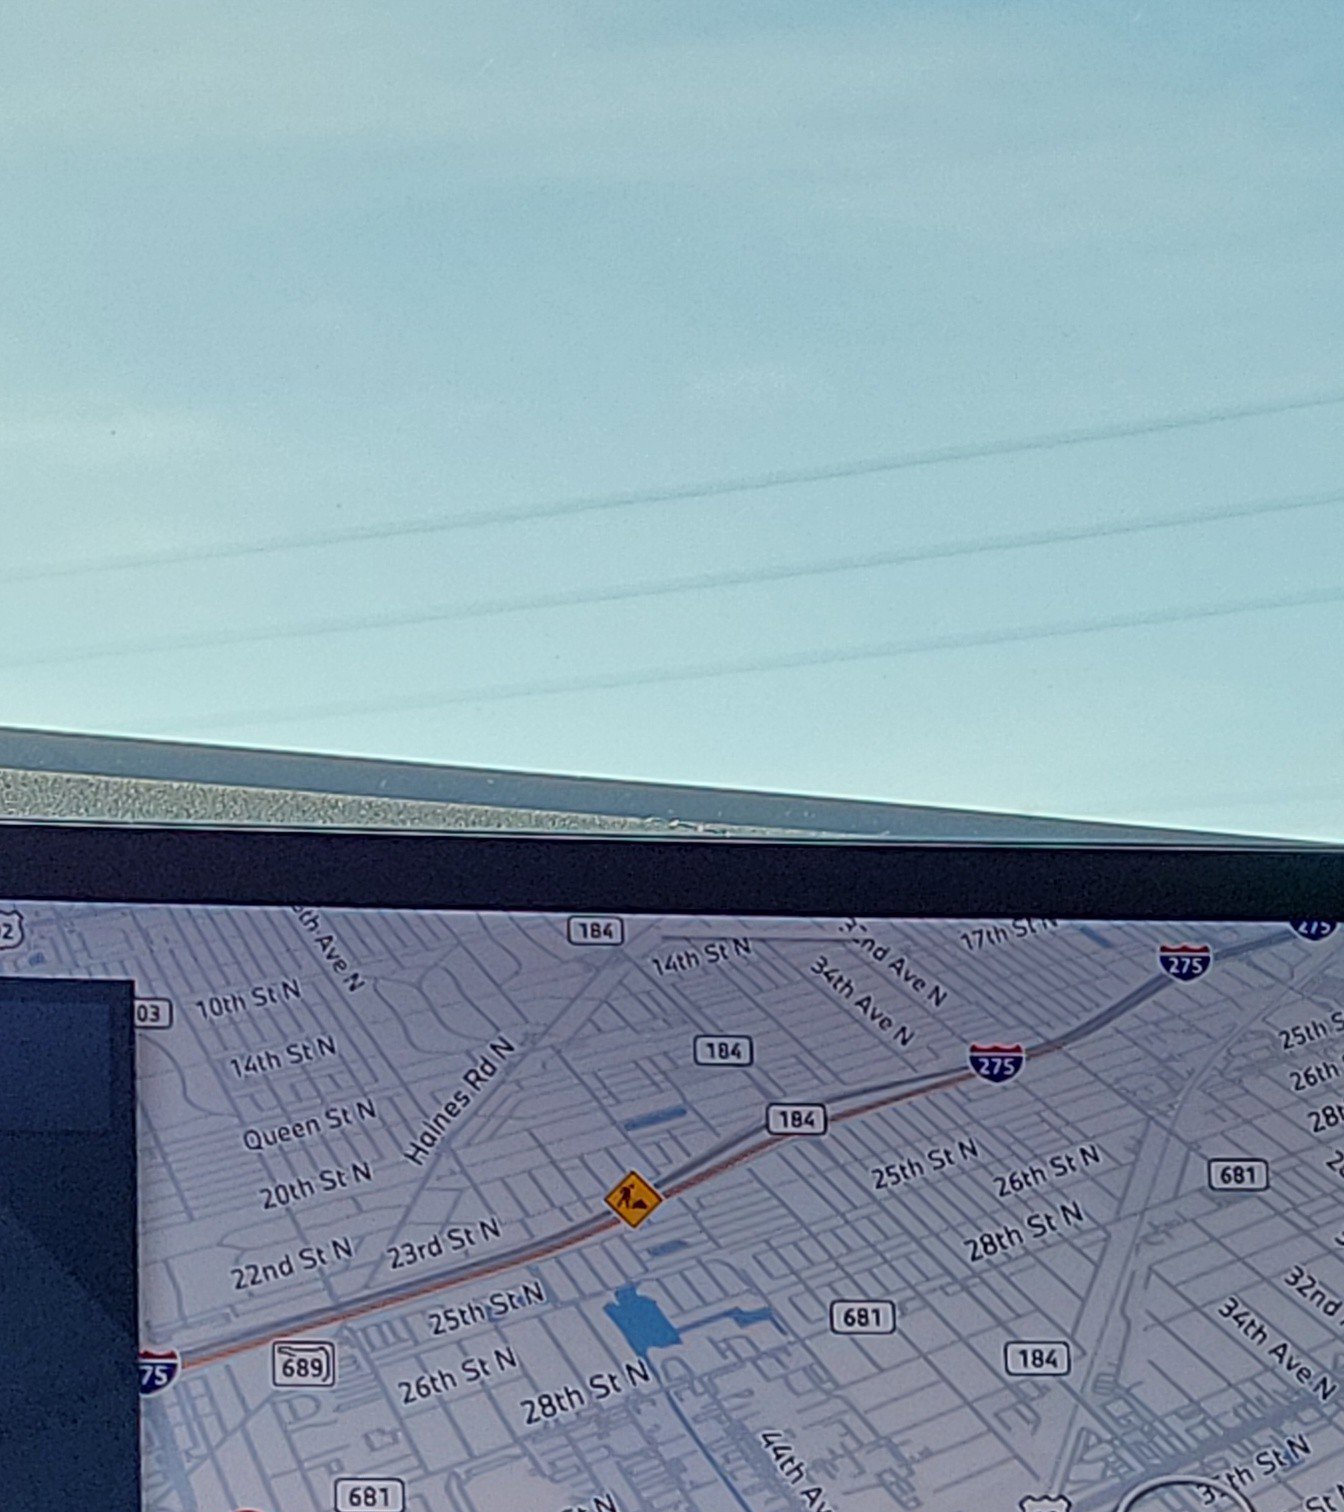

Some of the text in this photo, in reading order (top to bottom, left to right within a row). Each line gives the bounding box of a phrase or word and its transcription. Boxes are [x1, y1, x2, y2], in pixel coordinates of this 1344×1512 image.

[578, 922, 613, 939] 184
[1168, 957, 1203, 974] 275
[231, 1035, 337, 1079] 14th St N
[707, 1041, 741, 1059] 184
[979, 1058, 1015, 1076] 275
[1289, 1061, 1340, 1092] 26th
[403, 1035, 517, 1166] Haines Rd N
[780, 1109, 815, 1128] 184
[242, 1098, 377, 1152] Queen St N
[1220, 1167, 1256, 1184] 681
[386, 1218, 501, 1269] 23rd St N
[963, 1201, 1084, 1263] 28th St N
[230, 1237, 353, 1291] 22nd St N
[1283, 1264, 1339, 1318] 32nd
[842, 1308, 881, 1327] 681
[1217, 1296, 1338, 1401] 34th Ave N
[281, 1358, 322, 1377] 689
[520, 1359, 650, 1420] 28th St N
[760, 1432, 806, 1485] 44th
[349, 1487, 392, 1507] 681
